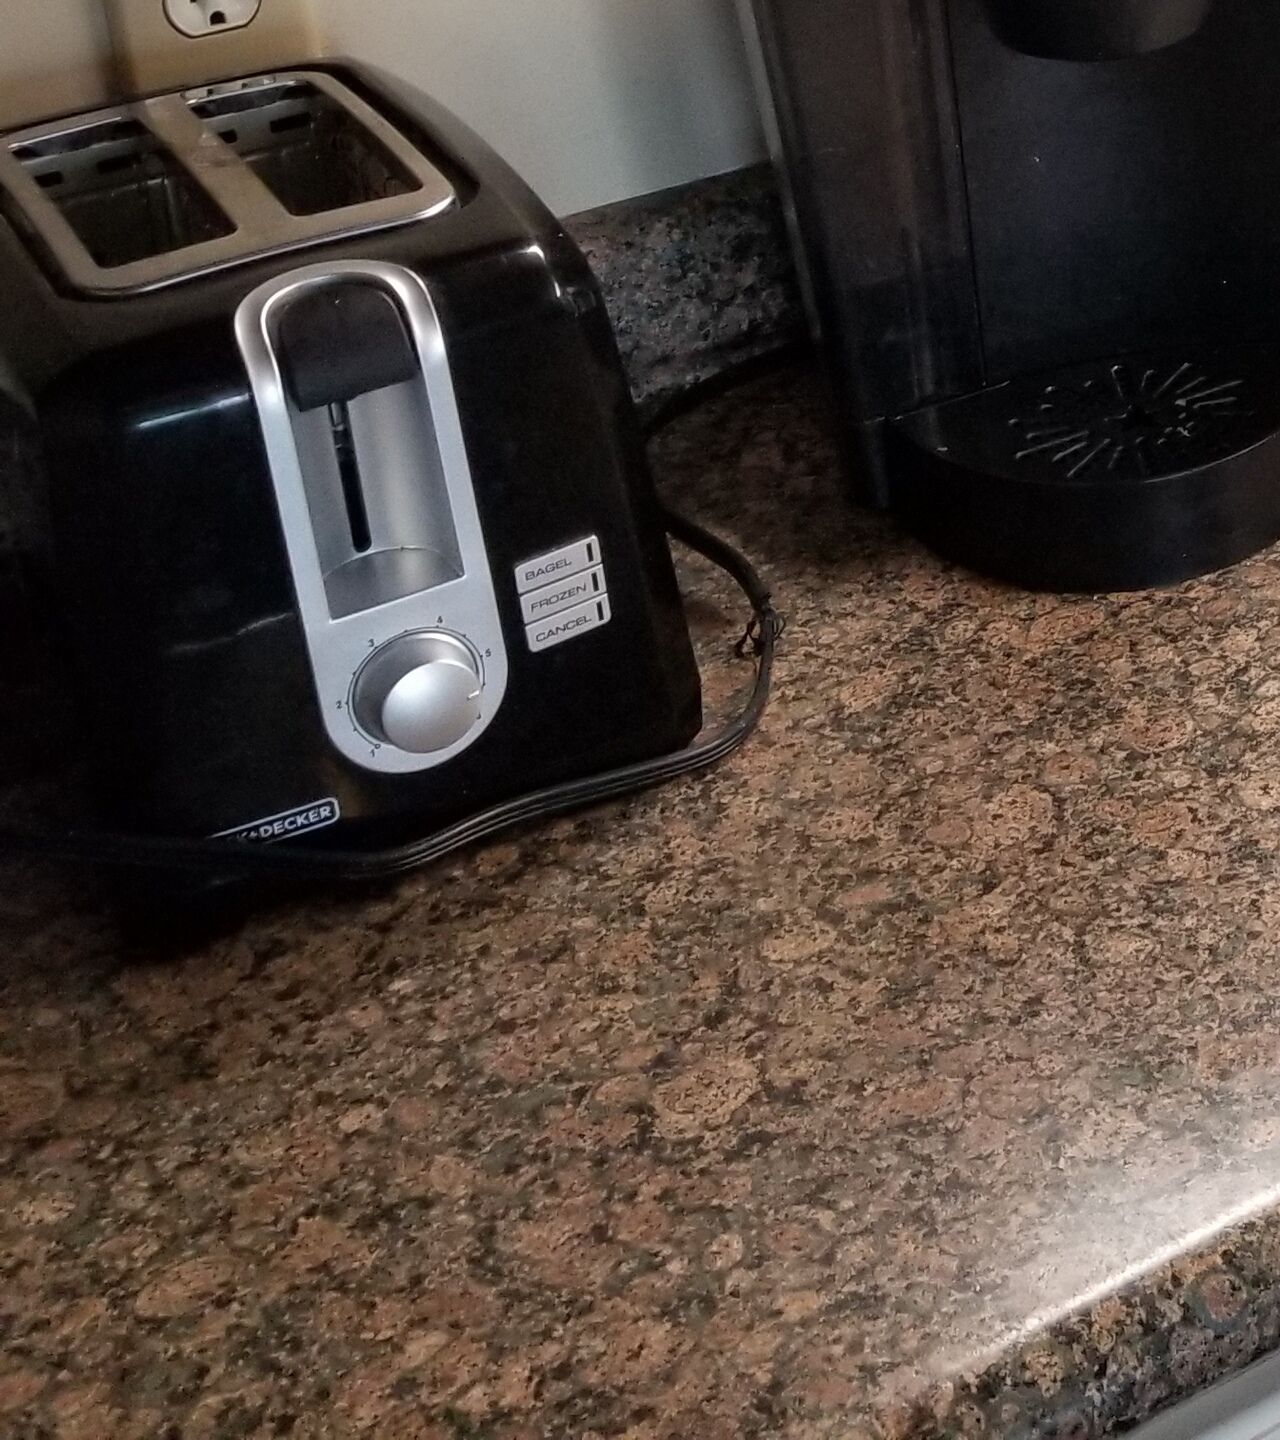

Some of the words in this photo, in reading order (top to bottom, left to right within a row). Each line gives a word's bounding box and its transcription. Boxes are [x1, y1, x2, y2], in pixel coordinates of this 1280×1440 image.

[524, 558, 572, 581] BAGEL
[530, 583, 587, 613] FROZEN
[535, 615, 592, 642] CANCEL
[368, 638, 375, 647] 3
[485, 649, 491, 658] 5
[336, 700, 342, 709] 2
